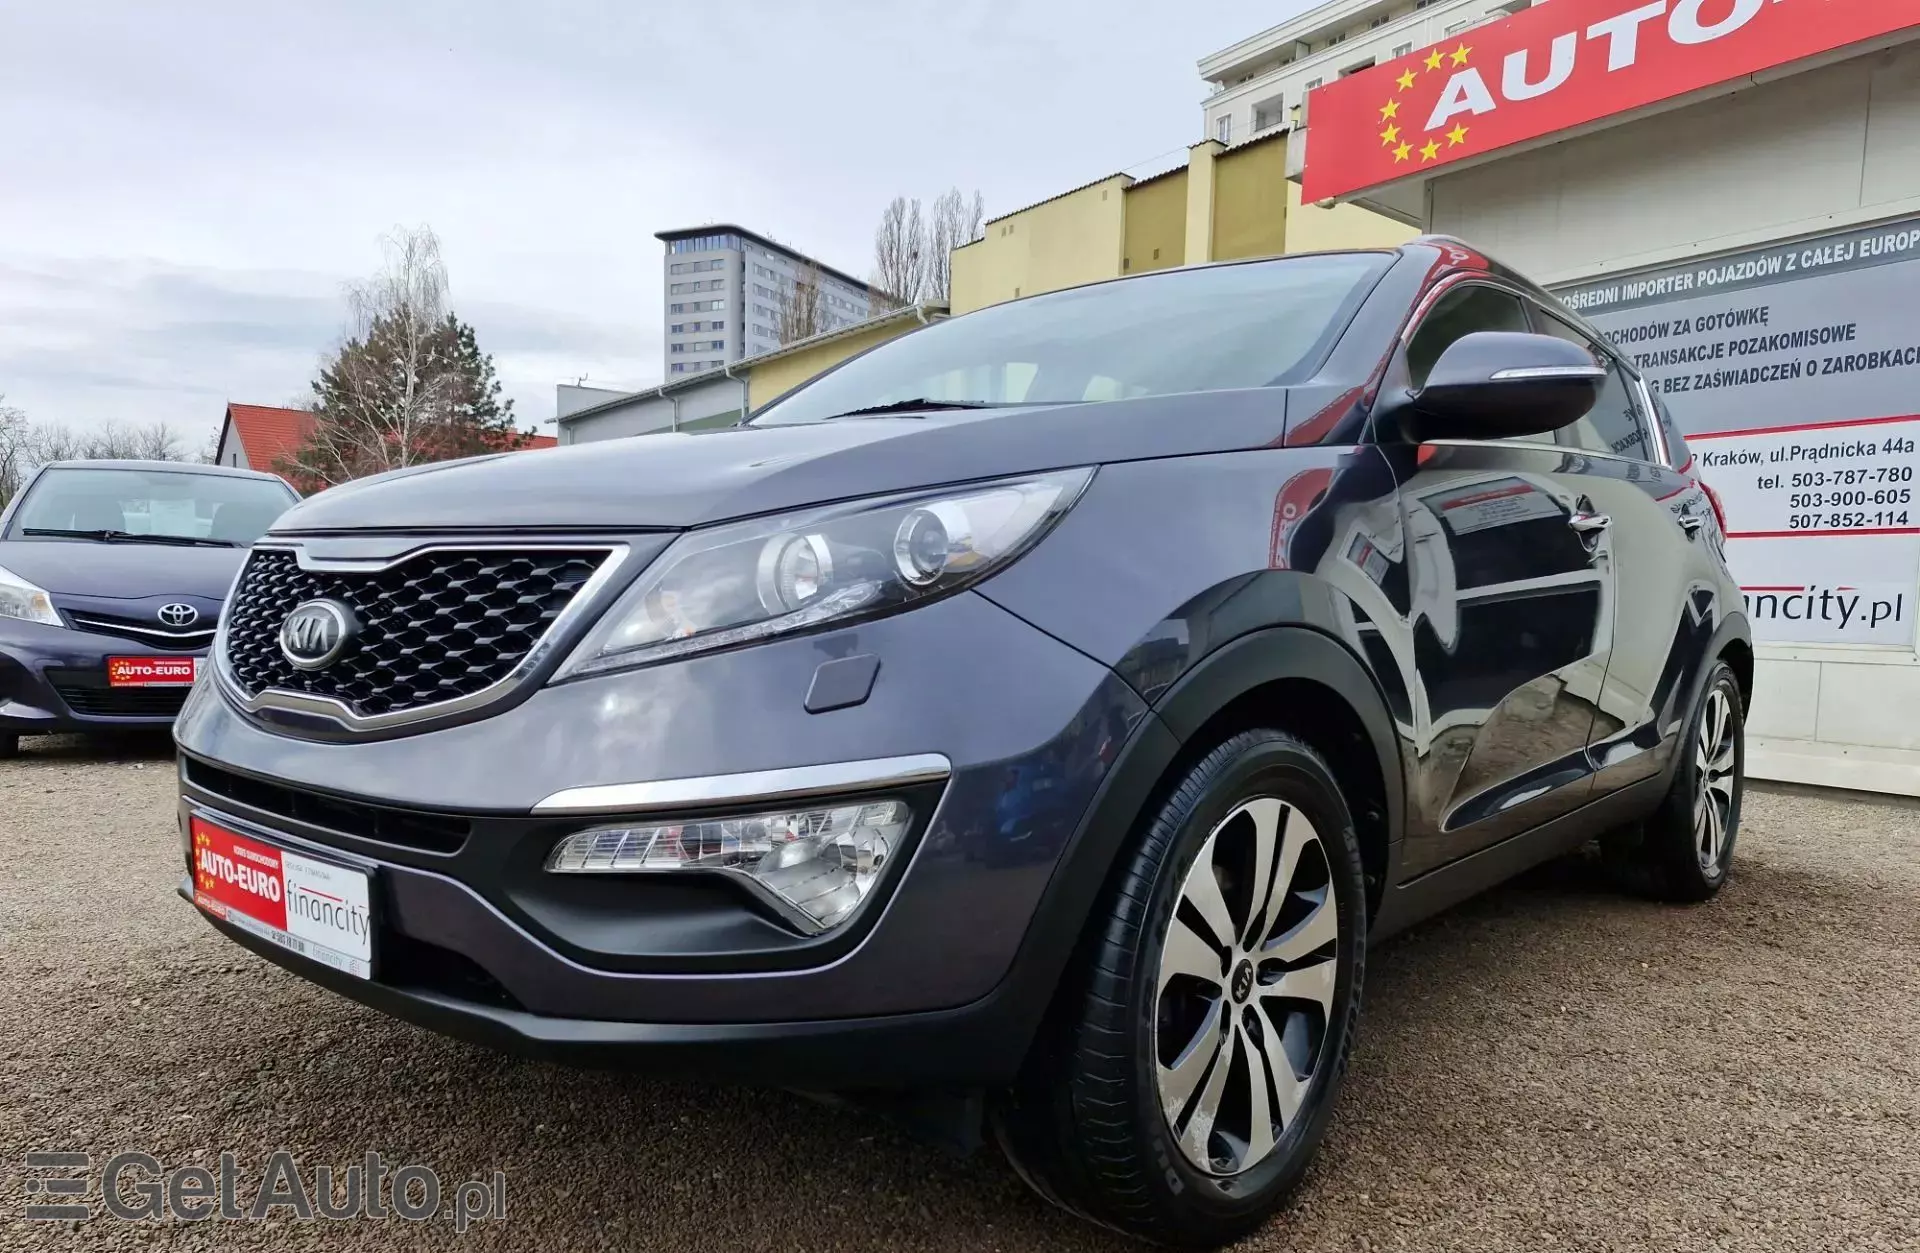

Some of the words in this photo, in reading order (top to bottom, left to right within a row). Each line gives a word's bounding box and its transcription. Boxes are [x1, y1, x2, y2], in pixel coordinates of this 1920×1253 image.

[1424, 0, 1763, 132] AUTO
[1559, 287, 1619, 310] OŚREDNI
[1622, 273, 1693, 300] IMPORTER
[1697, 255, 1783, 287] POJAZDÓW
[1785, 253, 1797, 271] Z
[1801, 244, 1854, 268] CAŁEJ
[1859, 229, 1920, 257] EUROP
[1672, 319, 1691, 336] ZA
[1696, 306, 1769, 332] GOTÓWKĘ
[1633, 343, 1725, 369] TRANSAKCJE
[1729, 323, 1857, 357] POZAKOMISOWE
[1663, 376, 1690, 394] BEZ
[1693, 358, 1801, 391] ZAŚWIADCZEŃ
[1806, 360, 1817, 376] O
[1702, 449, 1764, 467] Kraków,
[1770, 440, 1876, 464] ul.Prądnicka
[1882, 437, 1915, 454] 44a
[1757, 474, 1785, 489] tel.
[1791, 466, 1913, 488] 503-787-780
[1789, 488, 1911, 508] 503-900-605
[1789, 511, 1909, 529] 507-852-114
[1743, 585, 1903, 629] ncity.pl
[286, 616, 331, 652] KIA
[117, 666, 191, 675] AUTO-EURO
[200, 848, 281, 903] AUTO-EURO
[286, 879, 371, 946] financity
[1235, 967, 1252, 999] KIA
